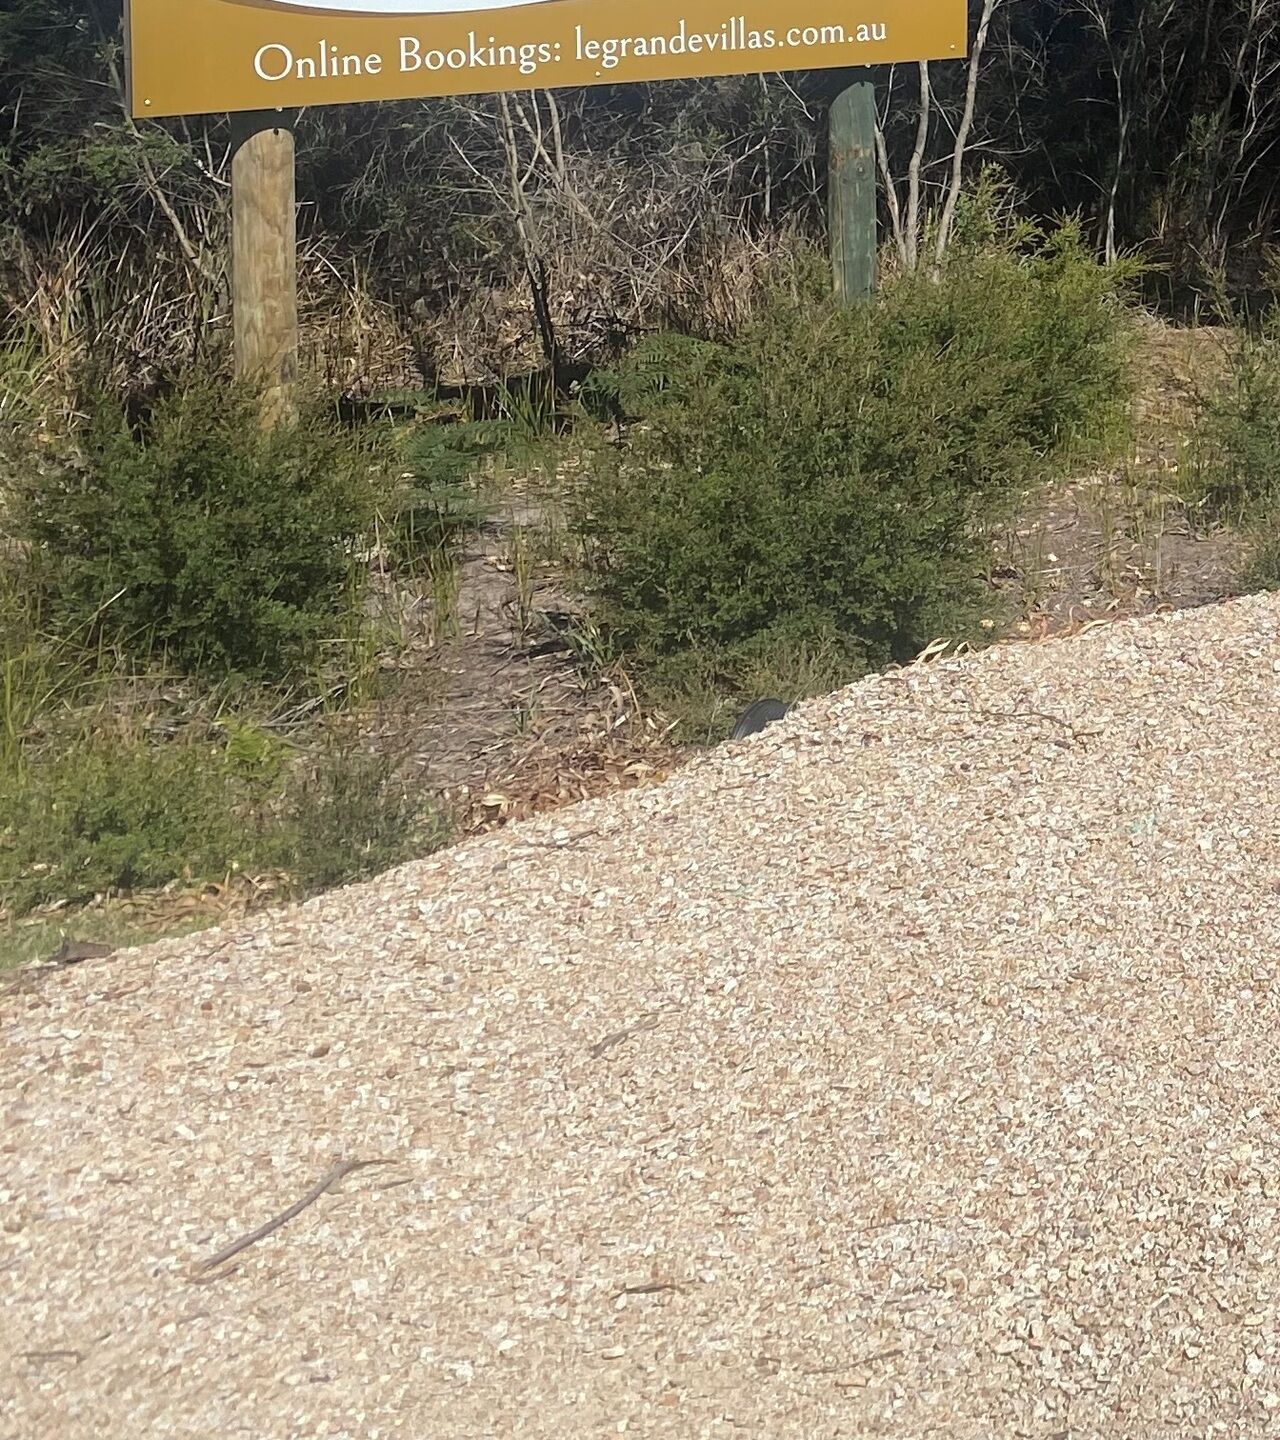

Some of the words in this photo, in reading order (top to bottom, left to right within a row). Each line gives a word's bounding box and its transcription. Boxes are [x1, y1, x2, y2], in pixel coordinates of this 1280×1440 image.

[252, 42, 382, 82] Online
[399, 32, 563, 76] Bookings:
[573, 15, 888, 66] legrandevillas.com.au
